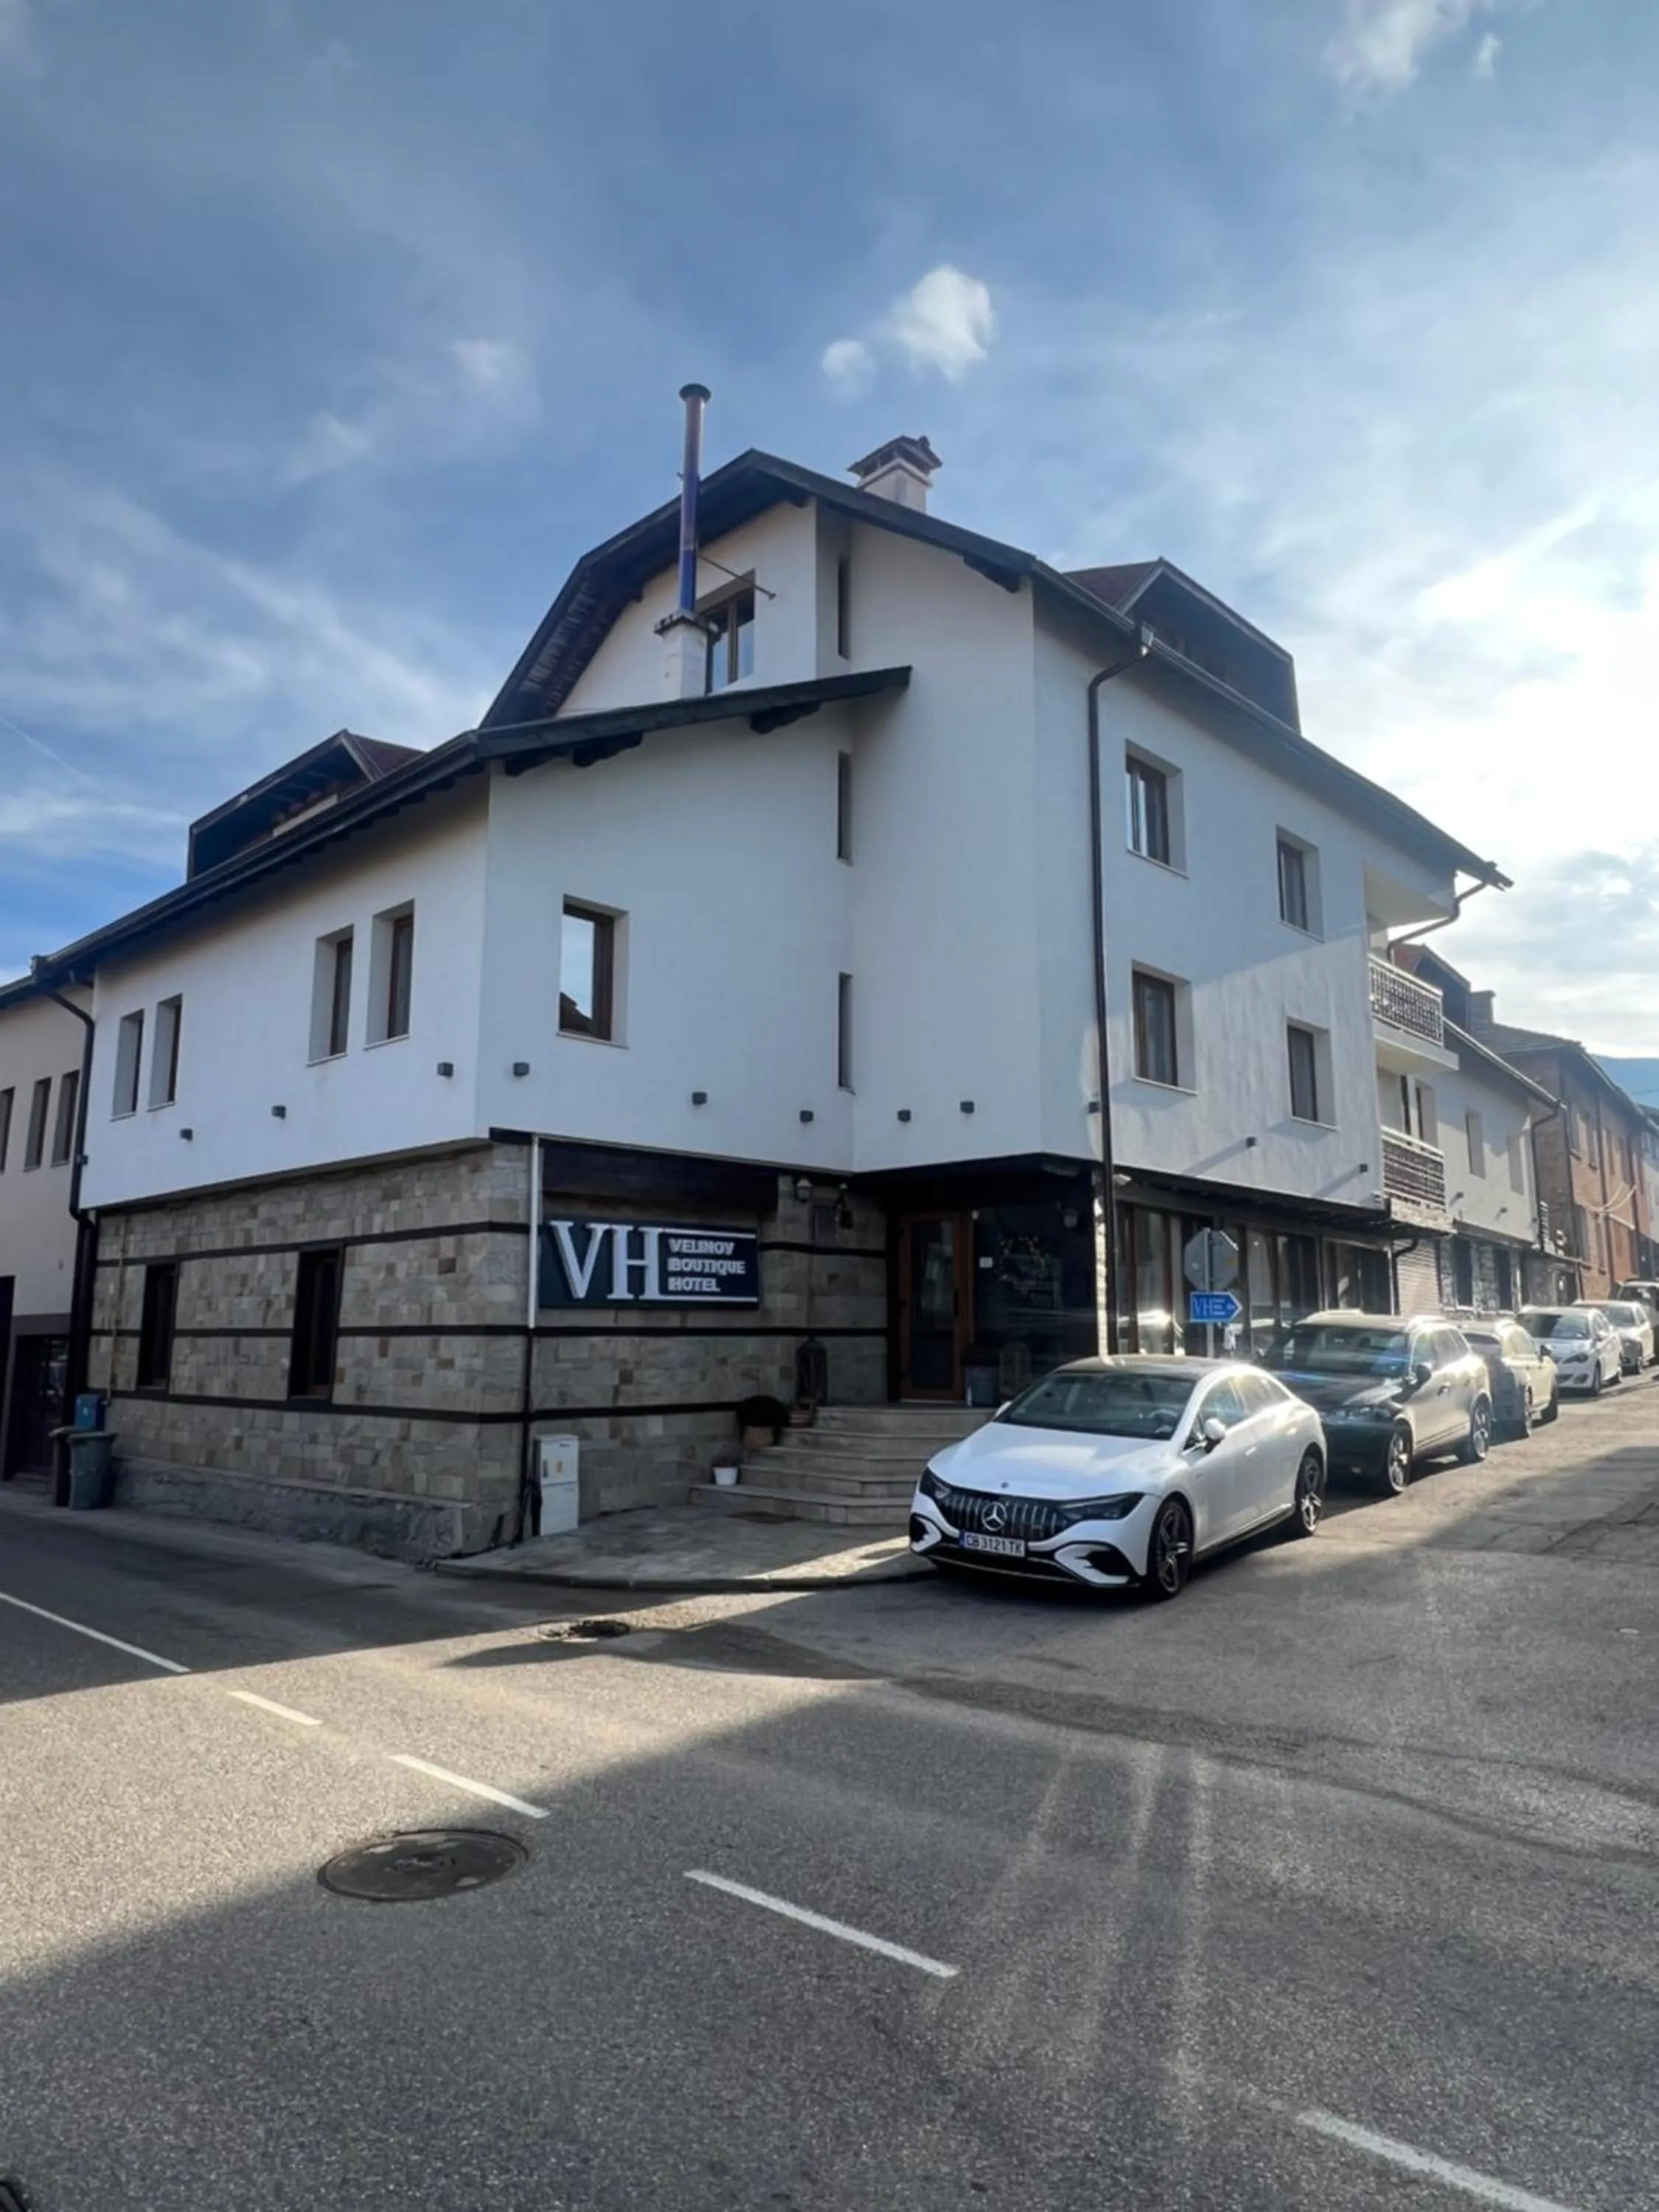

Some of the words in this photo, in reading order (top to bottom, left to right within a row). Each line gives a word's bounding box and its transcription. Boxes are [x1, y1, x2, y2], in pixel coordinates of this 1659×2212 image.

[668, 1238, 734, 1255] VELINOV
[549, 1220, 662, 1300] VH
[667, 1258, 746, 1276] BOUTIQUE
[668, 1276, 720, 1292] HOTEL
[981, 1537, 1006, 1552] 3121
